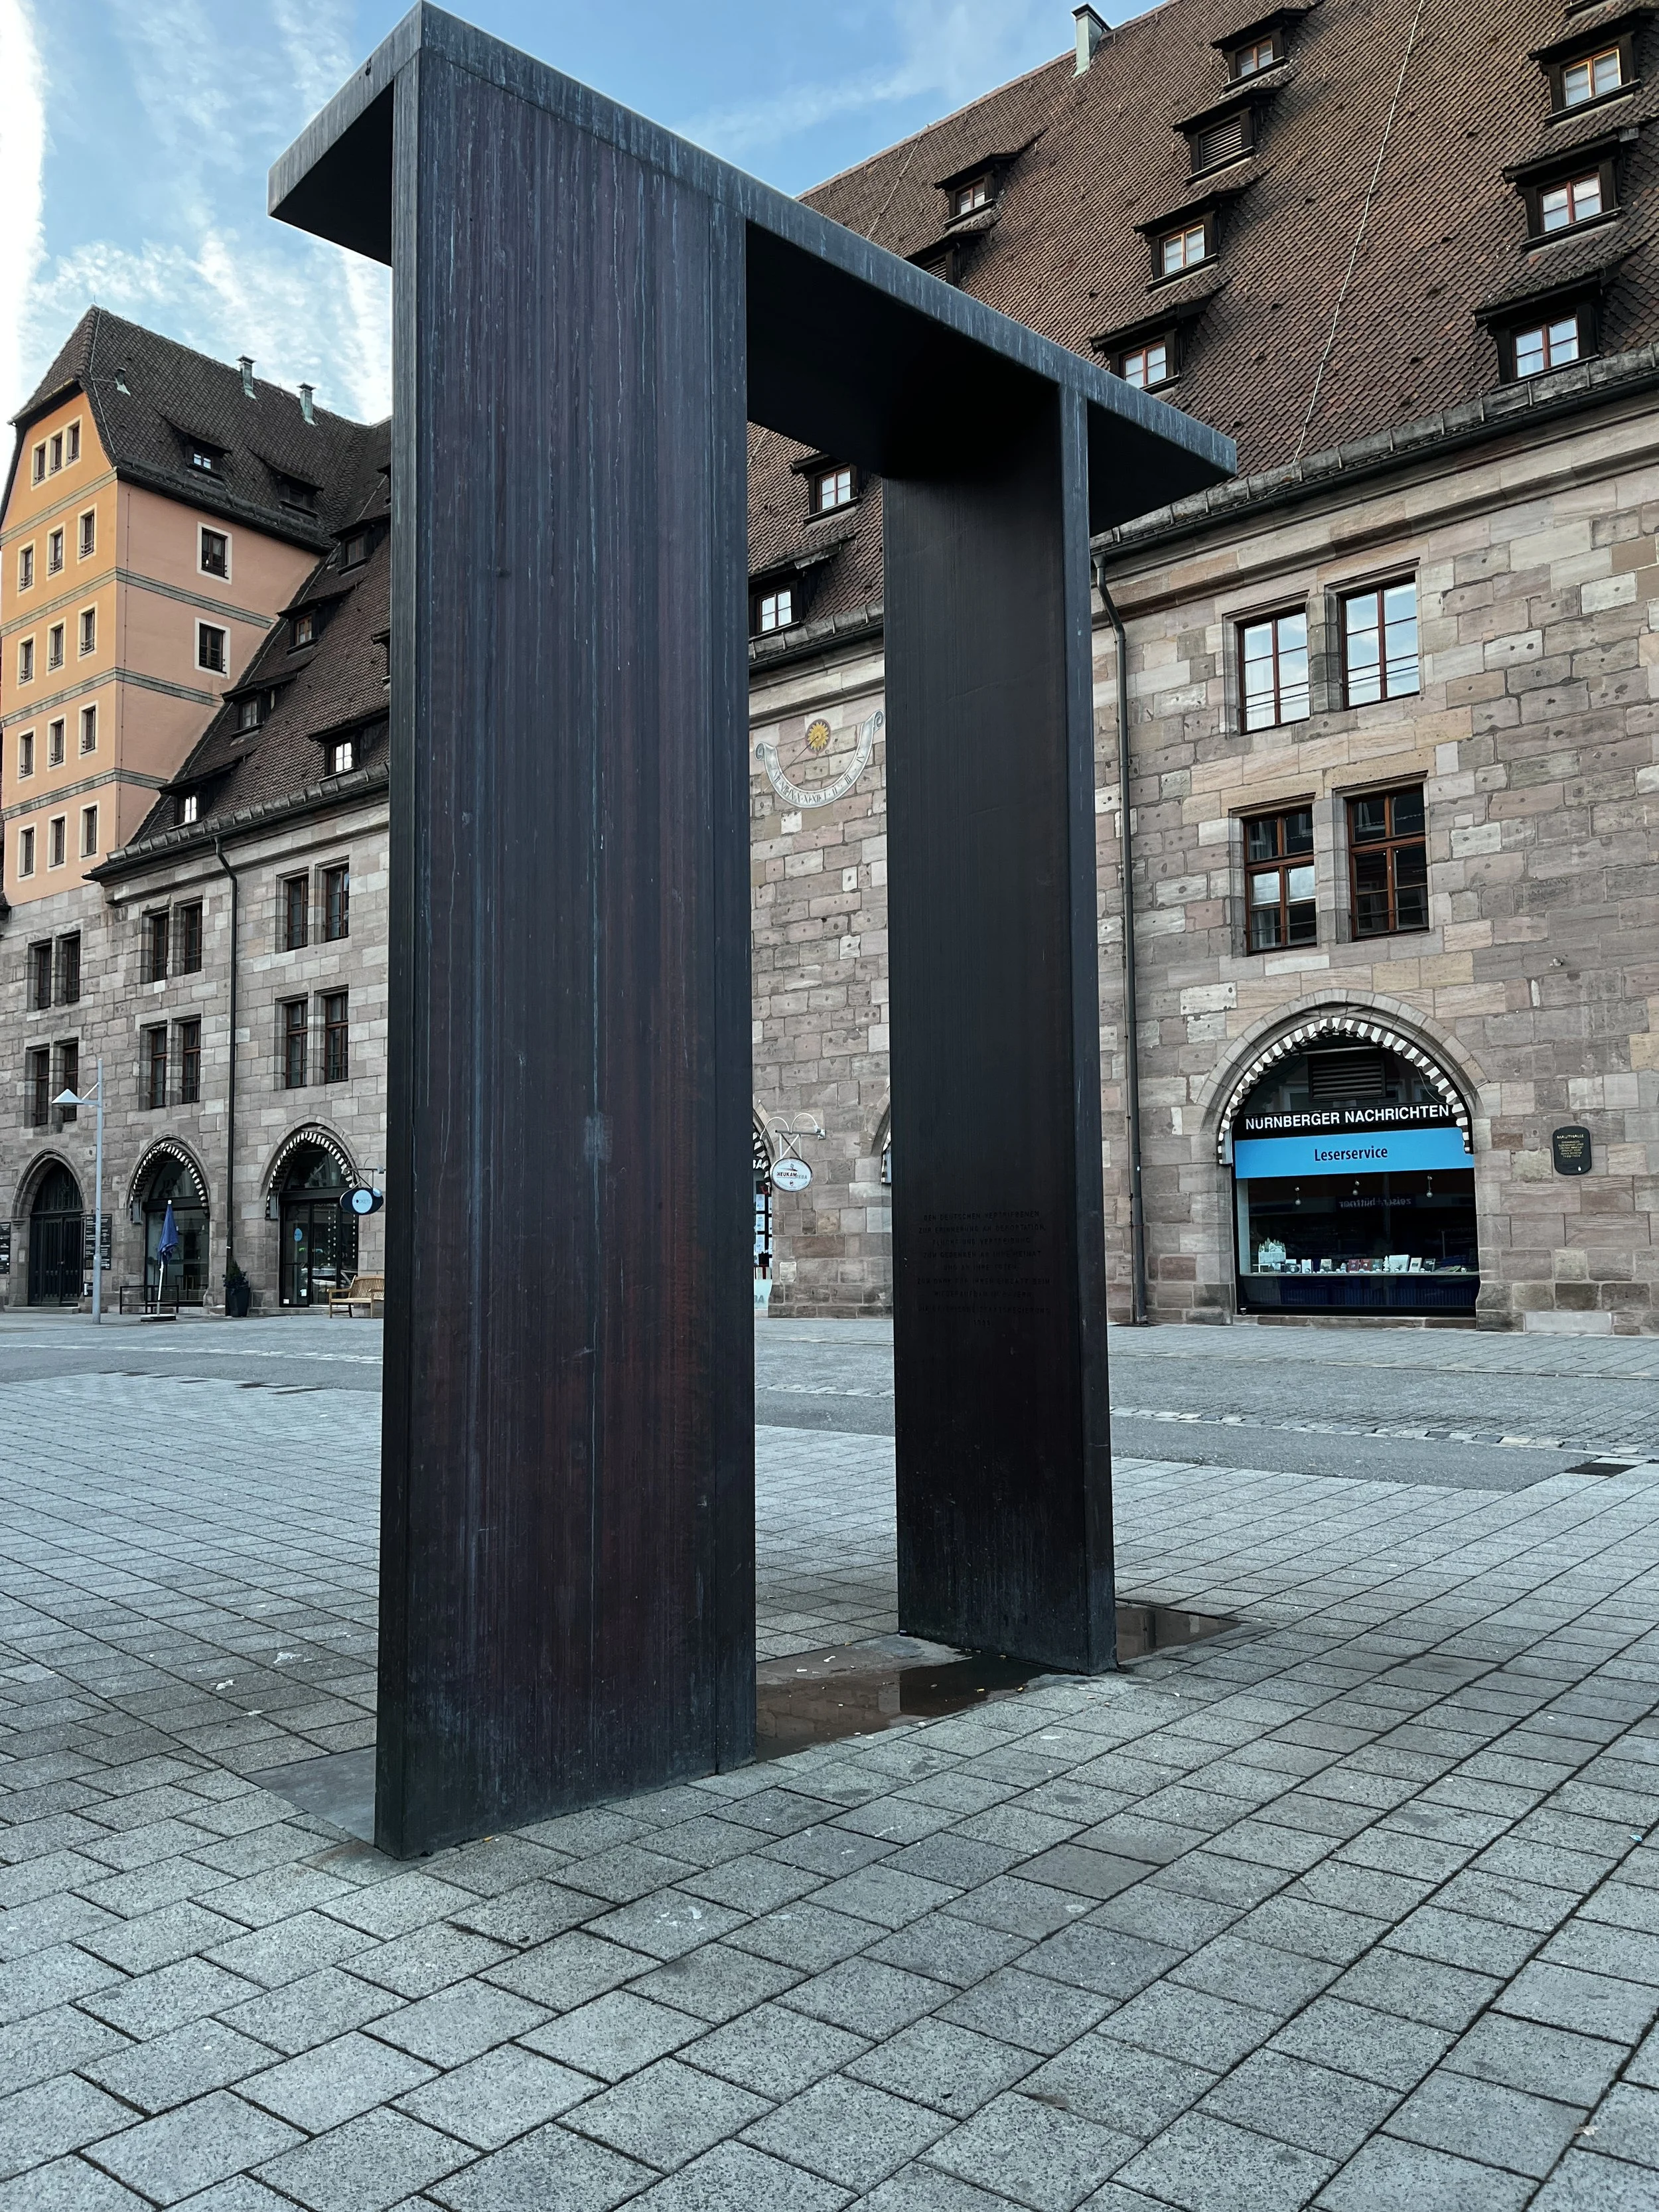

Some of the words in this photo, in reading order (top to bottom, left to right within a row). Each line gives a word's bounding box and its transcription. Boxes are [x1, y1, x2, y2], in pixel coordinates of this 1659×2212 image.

[844, 774, 853, 785] III
[1246, 1112, 1340, 1130] NÜRNBERGER
[1344, 1104, 1449, 1124] NACHRICHTEN
[1315, 1145, 1388, 1161] Leserservice
[940, 1213, 981, 1221] DEUTSCHEN
[985, 1211, 1039, 1219] VERTRIEBENEN
[934, 1225, 979, 1234] ERINNERUNG
